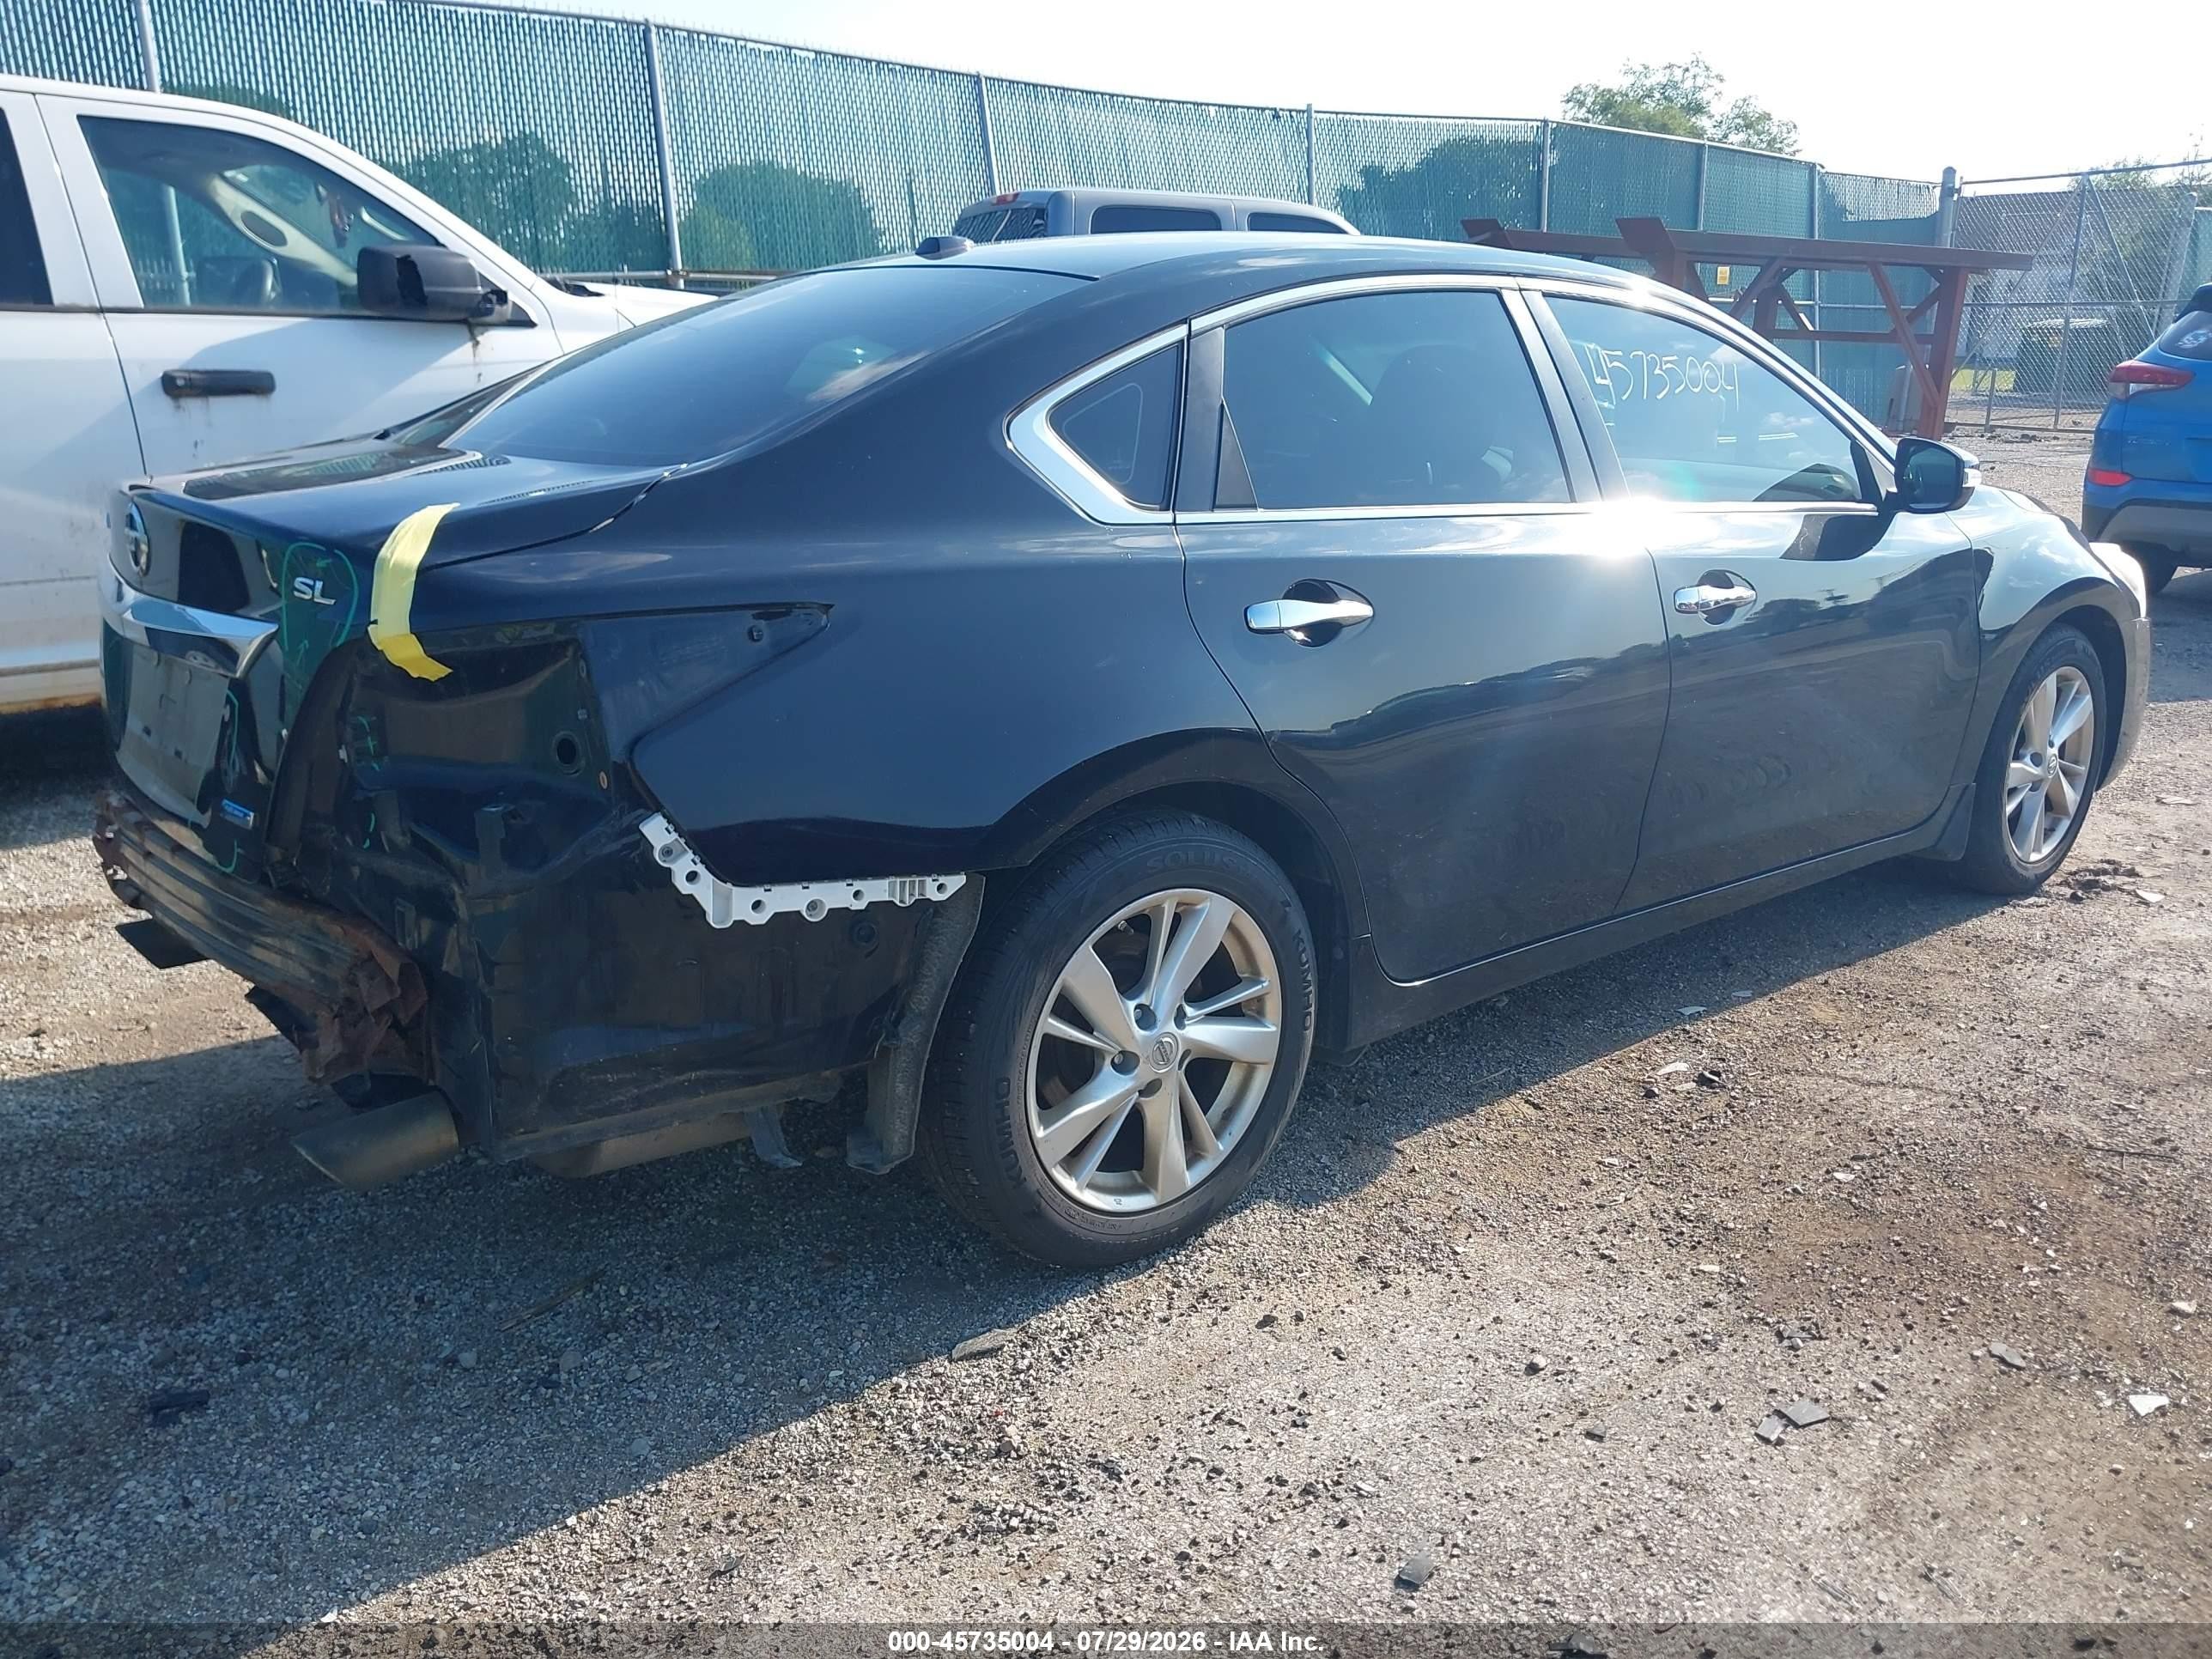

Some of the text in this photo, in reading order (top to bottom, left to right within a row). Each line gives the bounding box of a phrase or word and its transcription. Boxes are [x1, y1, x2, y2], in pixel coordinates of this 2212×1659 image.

[1584, 343, 1740, 412] 45735004
[293, 576, 337, 605] SL
[1292, 929, 1313, 1031] KUMHO
